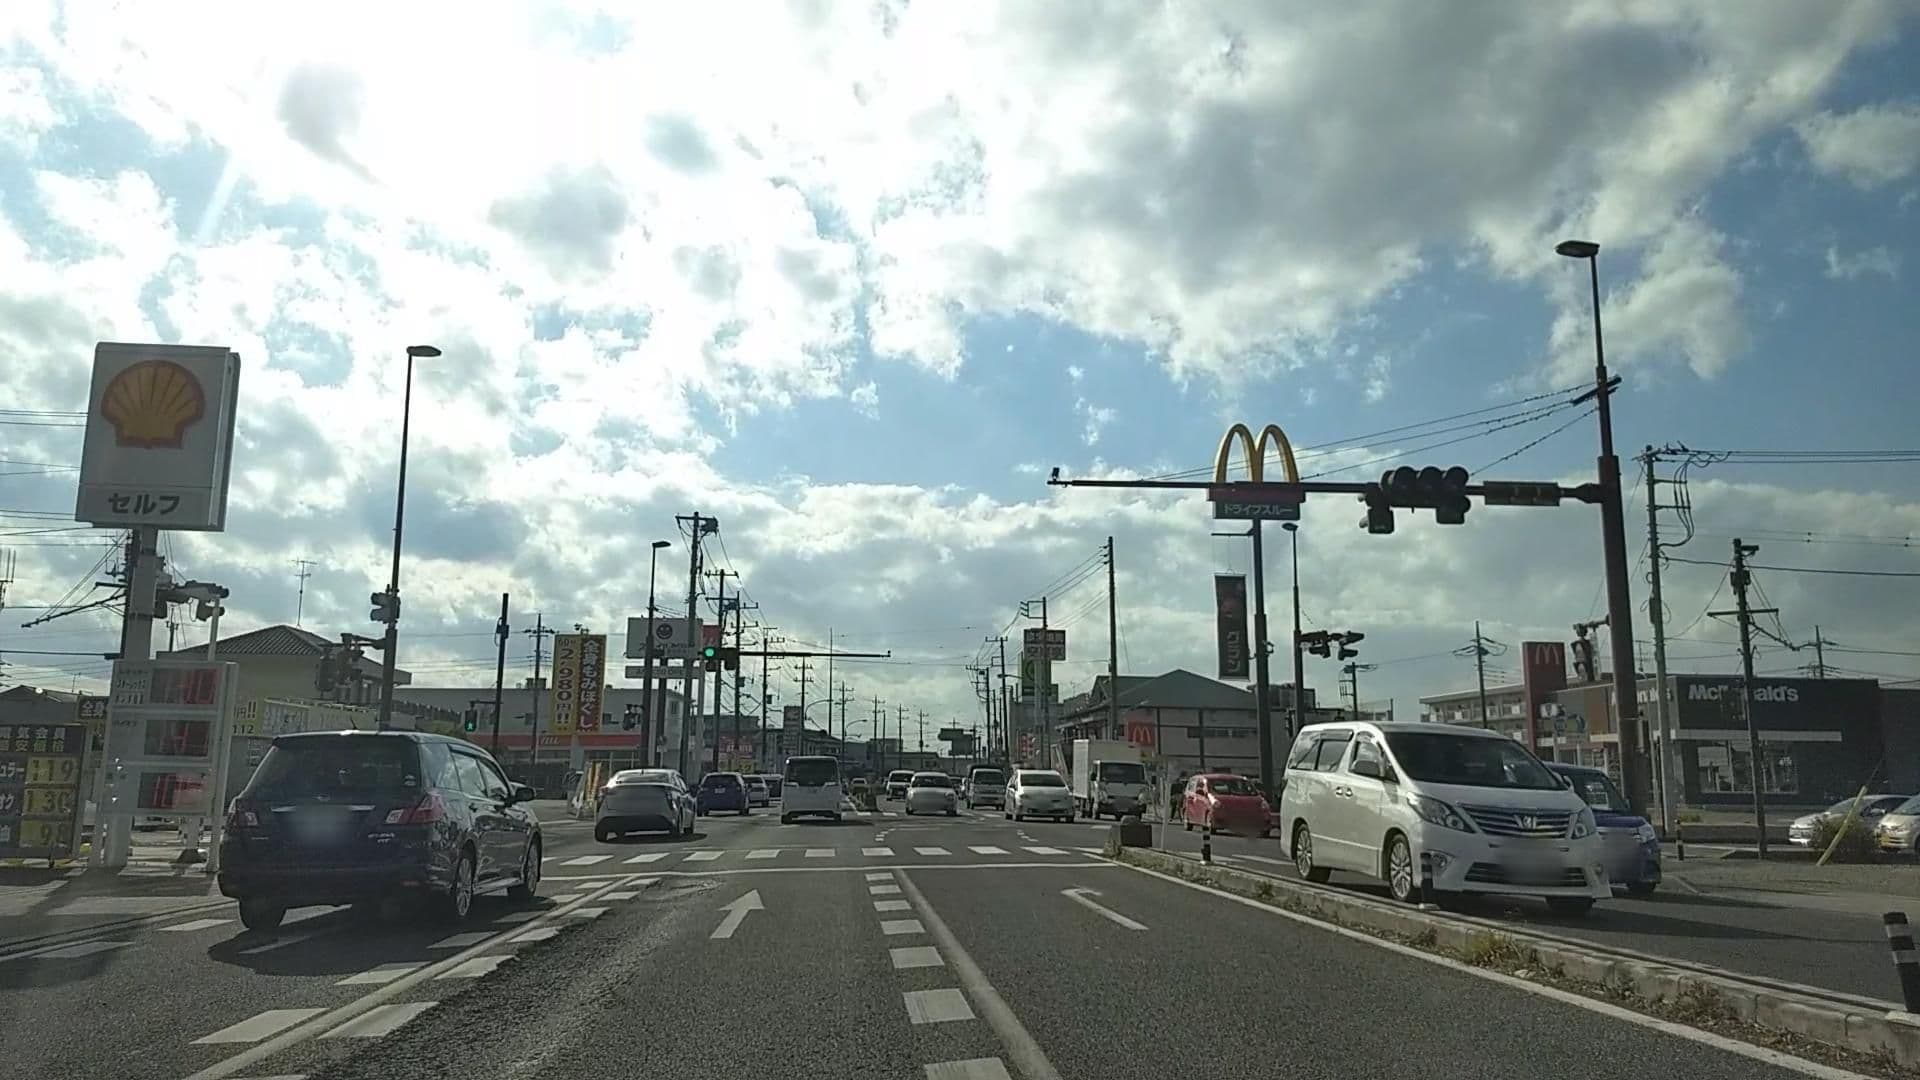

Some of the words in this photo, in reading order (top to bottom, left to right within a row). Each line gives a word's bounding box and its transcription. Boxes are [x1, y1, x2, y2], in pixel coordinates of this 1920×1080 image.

[108, 492, 180, 514] セルフ
[580, 639, 600, 729] 全身もみほぐし
[1688, 684, 1800, 703] Mcald's
